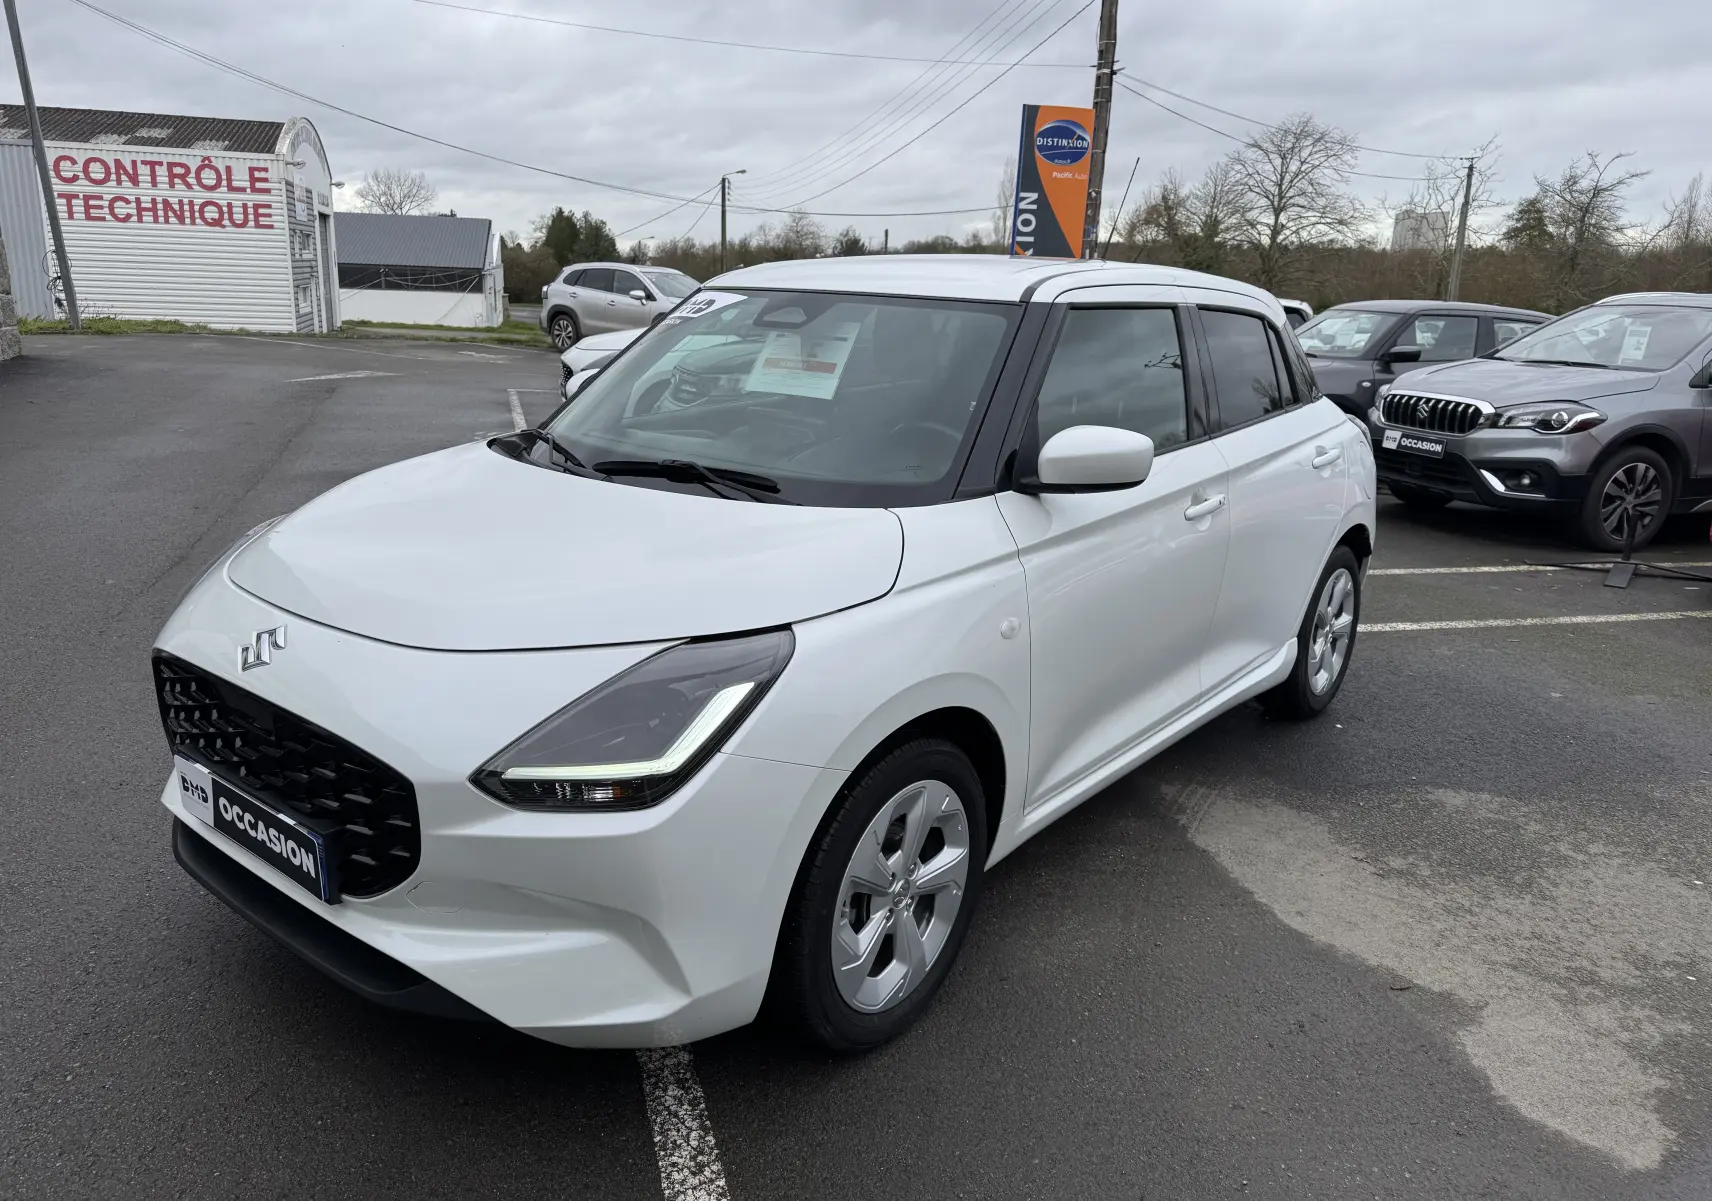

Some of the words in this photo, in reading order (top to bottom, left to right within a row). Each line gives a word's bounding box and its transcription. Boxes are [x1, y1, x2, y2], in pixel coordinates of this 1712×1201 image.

[1036, 137, 1088, 149] DISTINXION
[53, 155, 272, 194] CONTRÔLE
[1052, 171, 1073, 179] Pacific
[57, 193, 275, 229] TECHNIQUE
[1401, 438, 1442, 452] OCCASION
[218, 796, 316, 879] OCCASION
